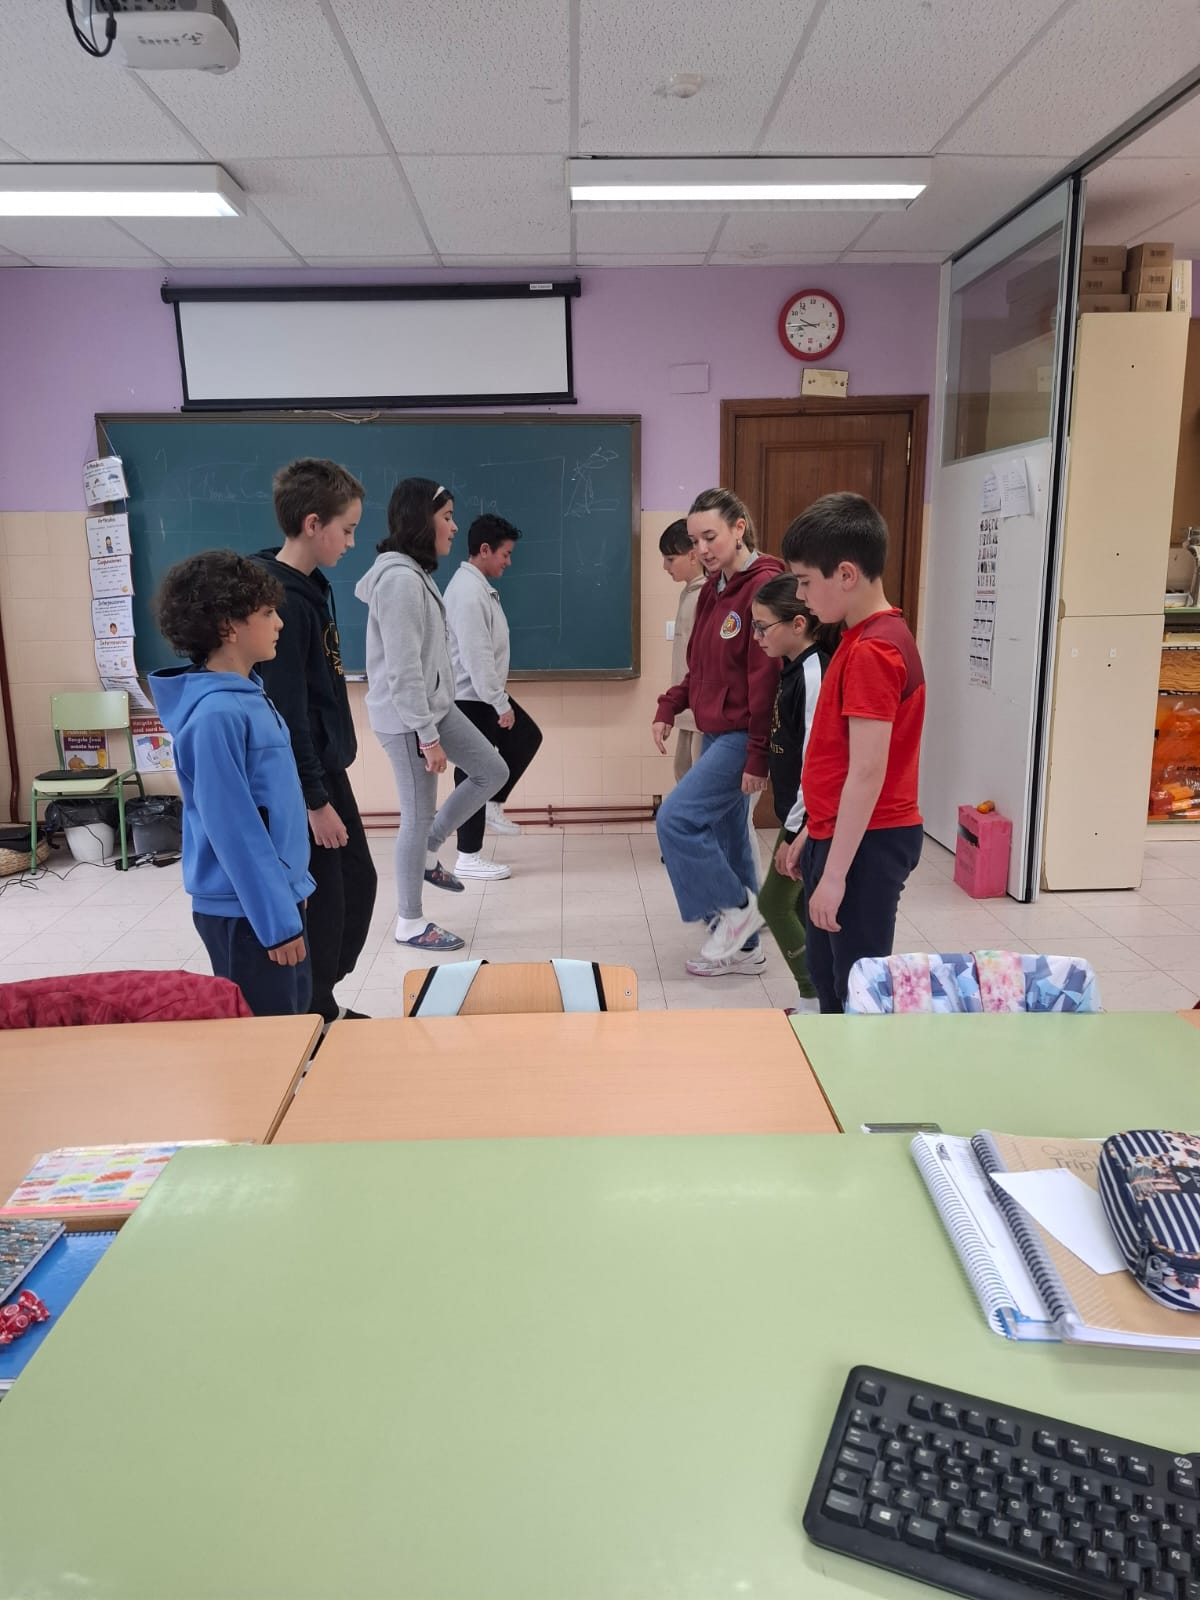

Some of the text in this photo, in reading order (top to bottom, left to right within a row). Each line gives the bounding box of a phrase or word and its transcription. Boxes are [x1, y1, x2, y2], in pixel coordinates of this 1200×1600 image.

[1007, 1475, 1014, 1483] T
[1036, 1485, 1045, 1493] Y
[1067, 1495, 1076, 1504] U
[1129, 1514, 1140, 1522] O
[902, 1489, 1098, 1559] Z X C V B N M
[1010, 1500, 1020, 1509] G
[1042, 1510, 1051, 1519] H
[1073, 1521, 1081, 1529] J
[1105, 1529, 1113, 1538] K
[1137, 1541, 1145, 1549] L
